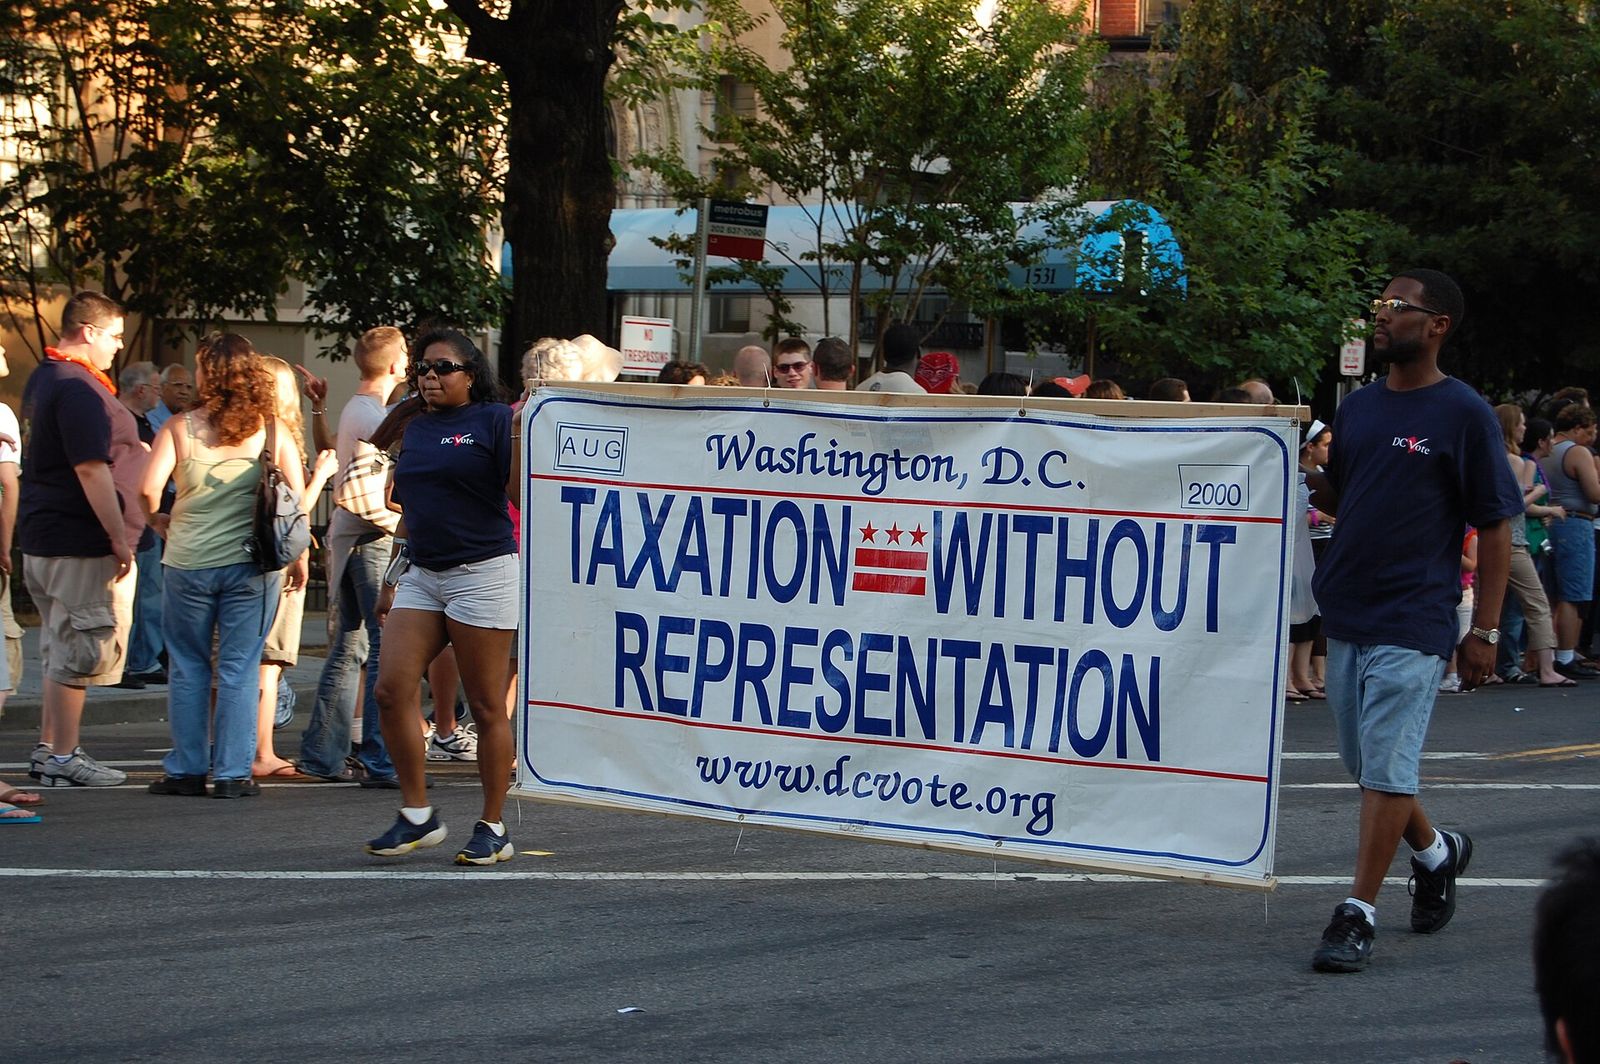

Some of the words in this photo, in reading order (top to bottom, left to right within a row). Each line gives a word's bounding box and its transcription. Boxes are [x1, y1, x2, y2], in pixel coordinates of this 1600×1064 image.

[714, 205, 763, 217] metrobus
[1024, 267, 1056, 285] 1531
[644, 329, 653, 341] NO
[624, 349, 669, 364] TRESPASSING
[440, 437, 455, 445] DC
[455, 433, 475, 446] Vote
[561, 436, 621, 460] AUG
[1392, 436, 1408, 448] DC
[1408, 438, 1430, 455] Vote
[706, 430, 968, 496] Washington,
[982, 446, 1086, 491] D.C.
[1188, 483, 1242, 507] 2000
[561, 486, 851, 607] TAXATION
[933, 510, 1237, 633] WITHOUT
[615, 610, 1160, 762] REPRESENTATION
[696, 755, 1056, 837] www.dcvote.org
